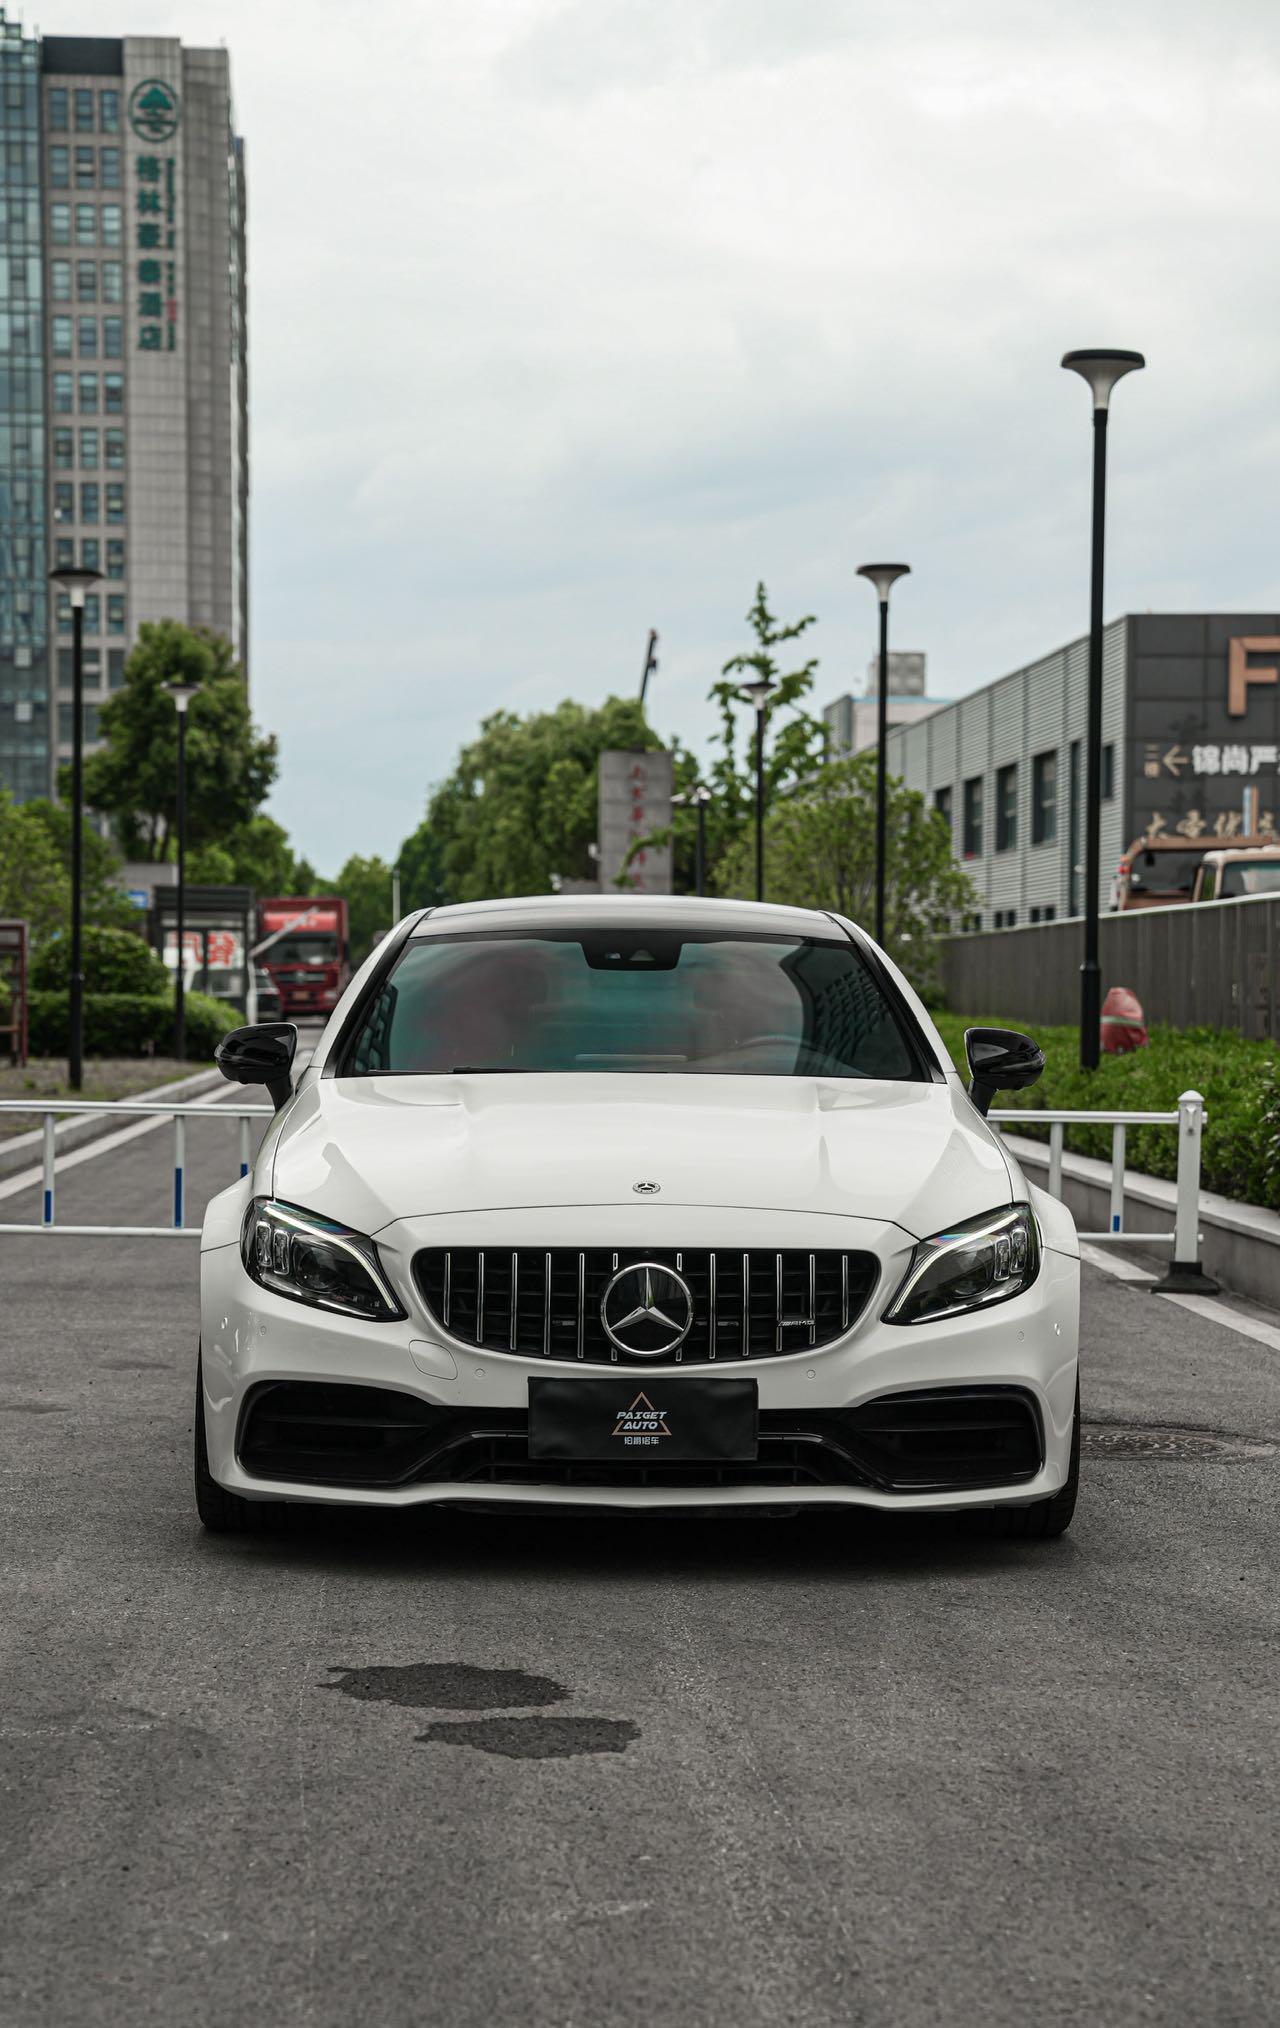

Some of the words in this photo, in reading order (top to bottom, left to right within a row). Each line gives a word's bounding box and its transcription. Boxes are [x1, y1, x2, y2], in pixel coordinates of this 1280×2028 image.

[1228, 635, 1280, 716] F
[1192, 744, 1280, 775] 锦尚严
[616, 1411, 667, 1420] PAIGET
[623, 1421, 658, 1430] AUTO
